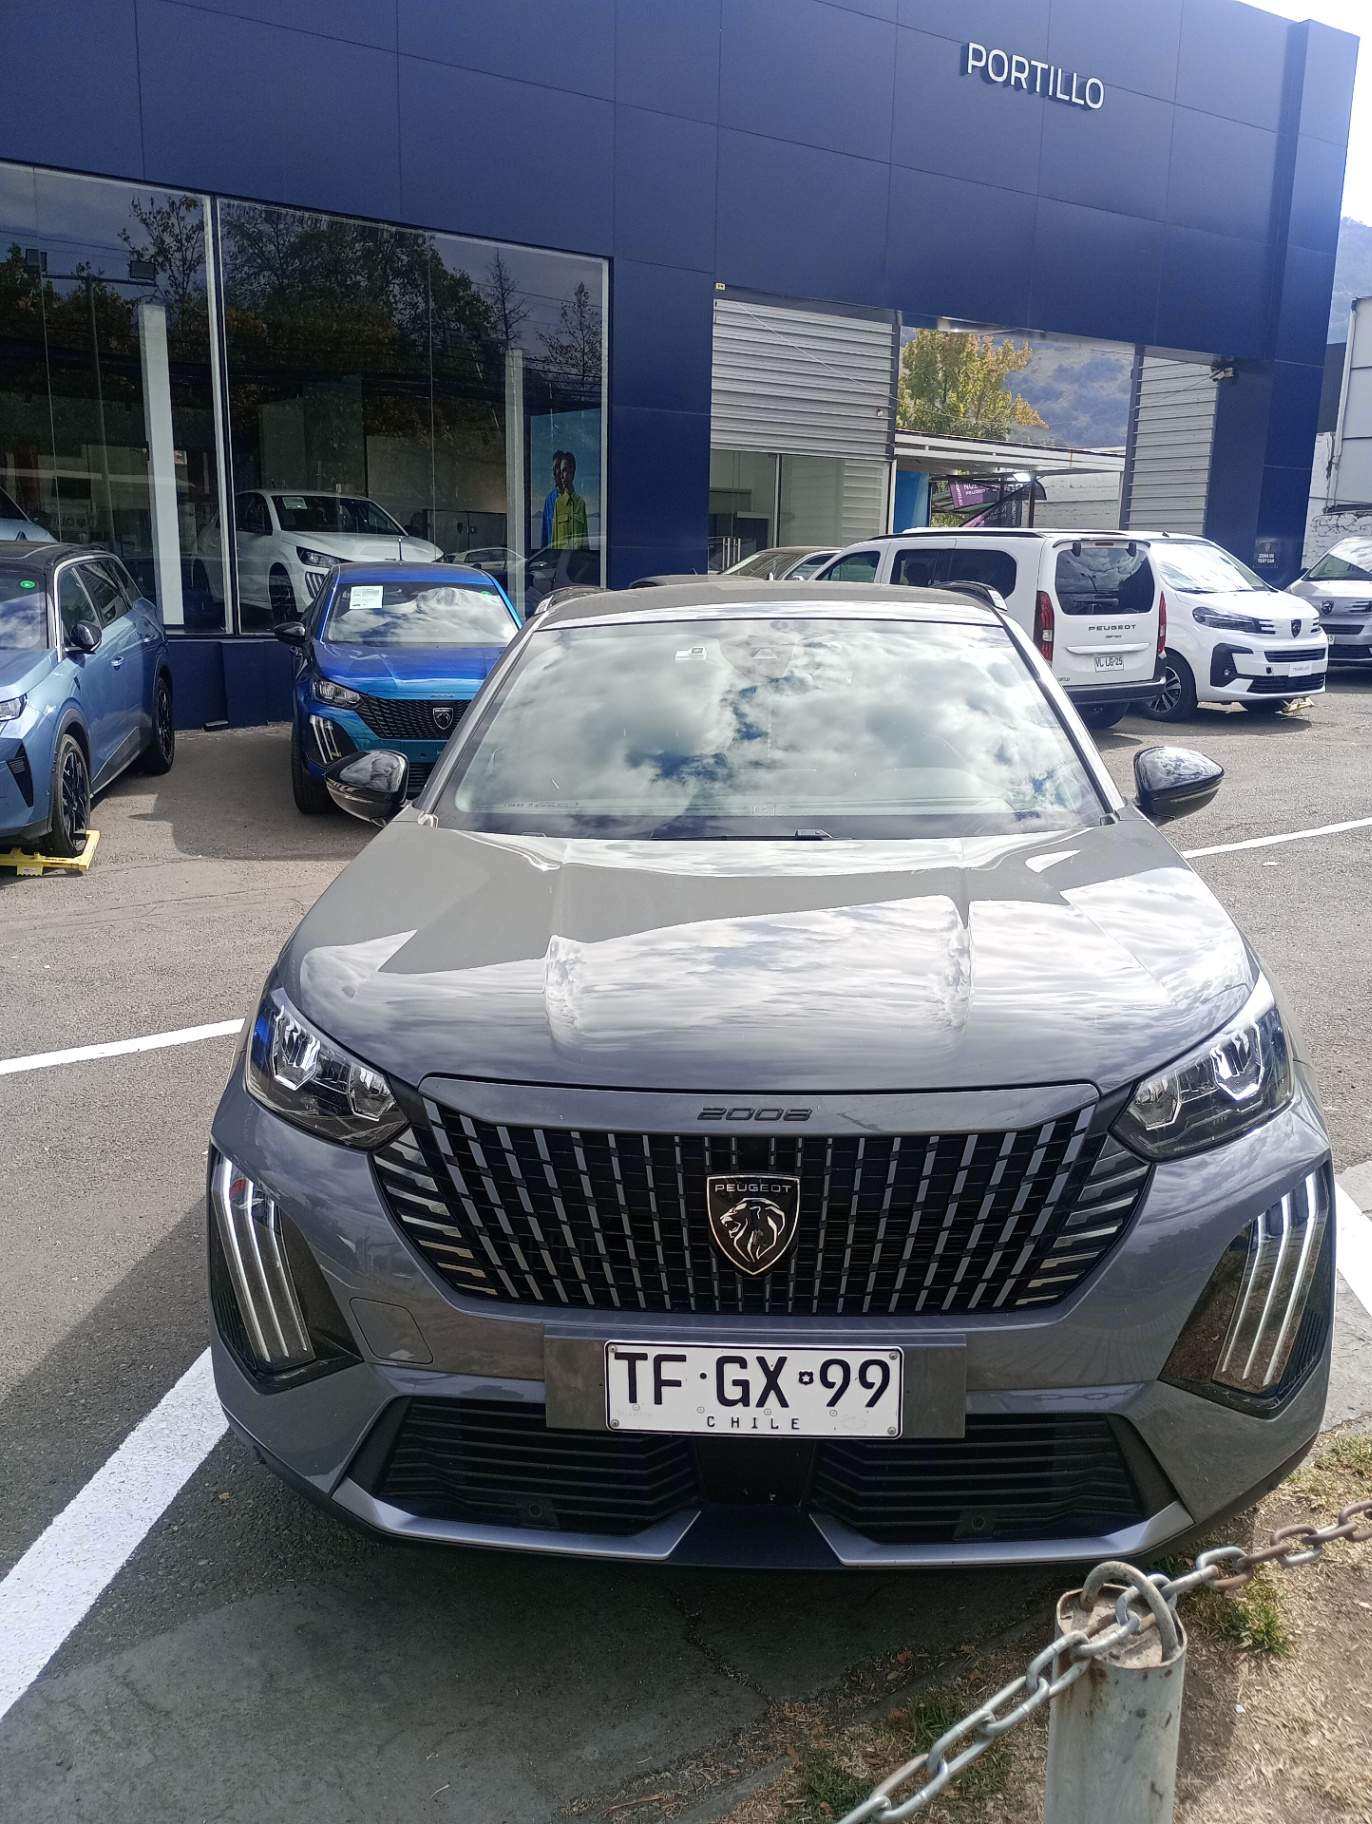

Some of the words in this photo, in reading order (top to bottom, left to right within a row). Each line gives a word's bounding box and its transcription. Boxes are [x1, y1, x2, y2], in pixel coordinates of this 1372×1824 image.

[967, 42, 1105, 110] PORTILLO
[696, 1107, 813, 1122] 2008
[714, 1183, 793, 1194] PEUGEOT
[706, 1415, 801, 1431] CHILE
